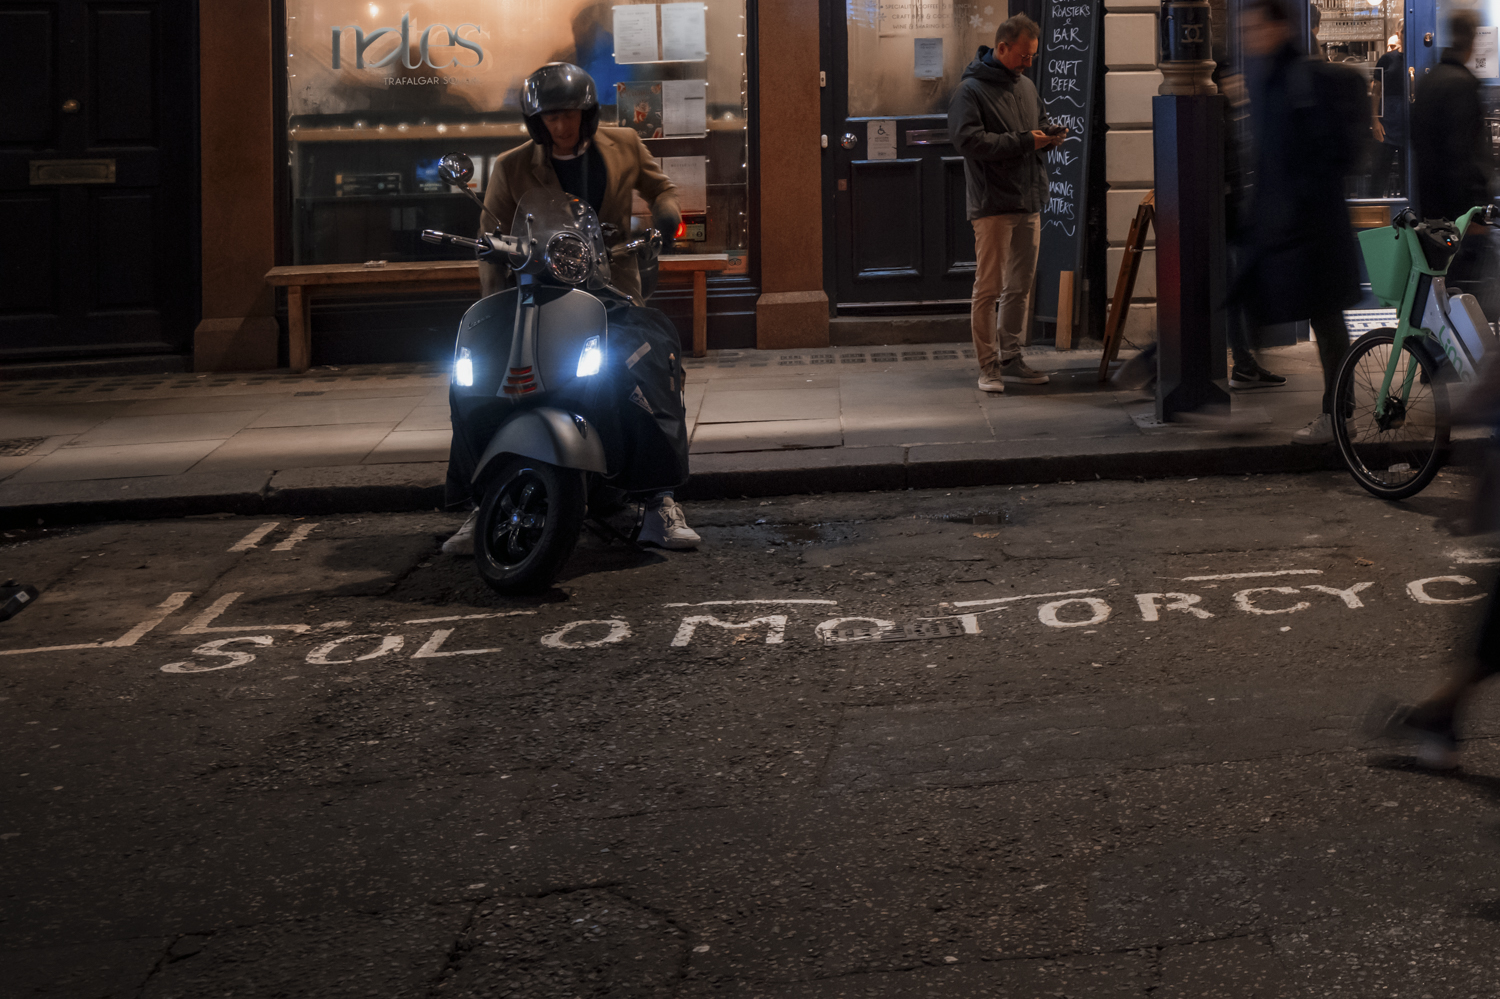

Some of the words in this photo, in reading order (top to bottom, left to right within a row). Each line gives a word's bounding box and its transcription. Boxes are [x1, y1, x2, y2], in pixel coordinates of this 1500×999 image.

[331, 11, 484, 70] notes
[1053, 27, 1083, 43] BAR
[1048, 59, 1083, 76] CRAFT
[383, 76, 440, 86] TRAFALGAR
[1051, 76, 1081, 92] BEER
[1047, 146, 1079, 165] WINE
[1043, 197, 1075, 220] LATTERS
[160, 616, 633, 674] SOLO
